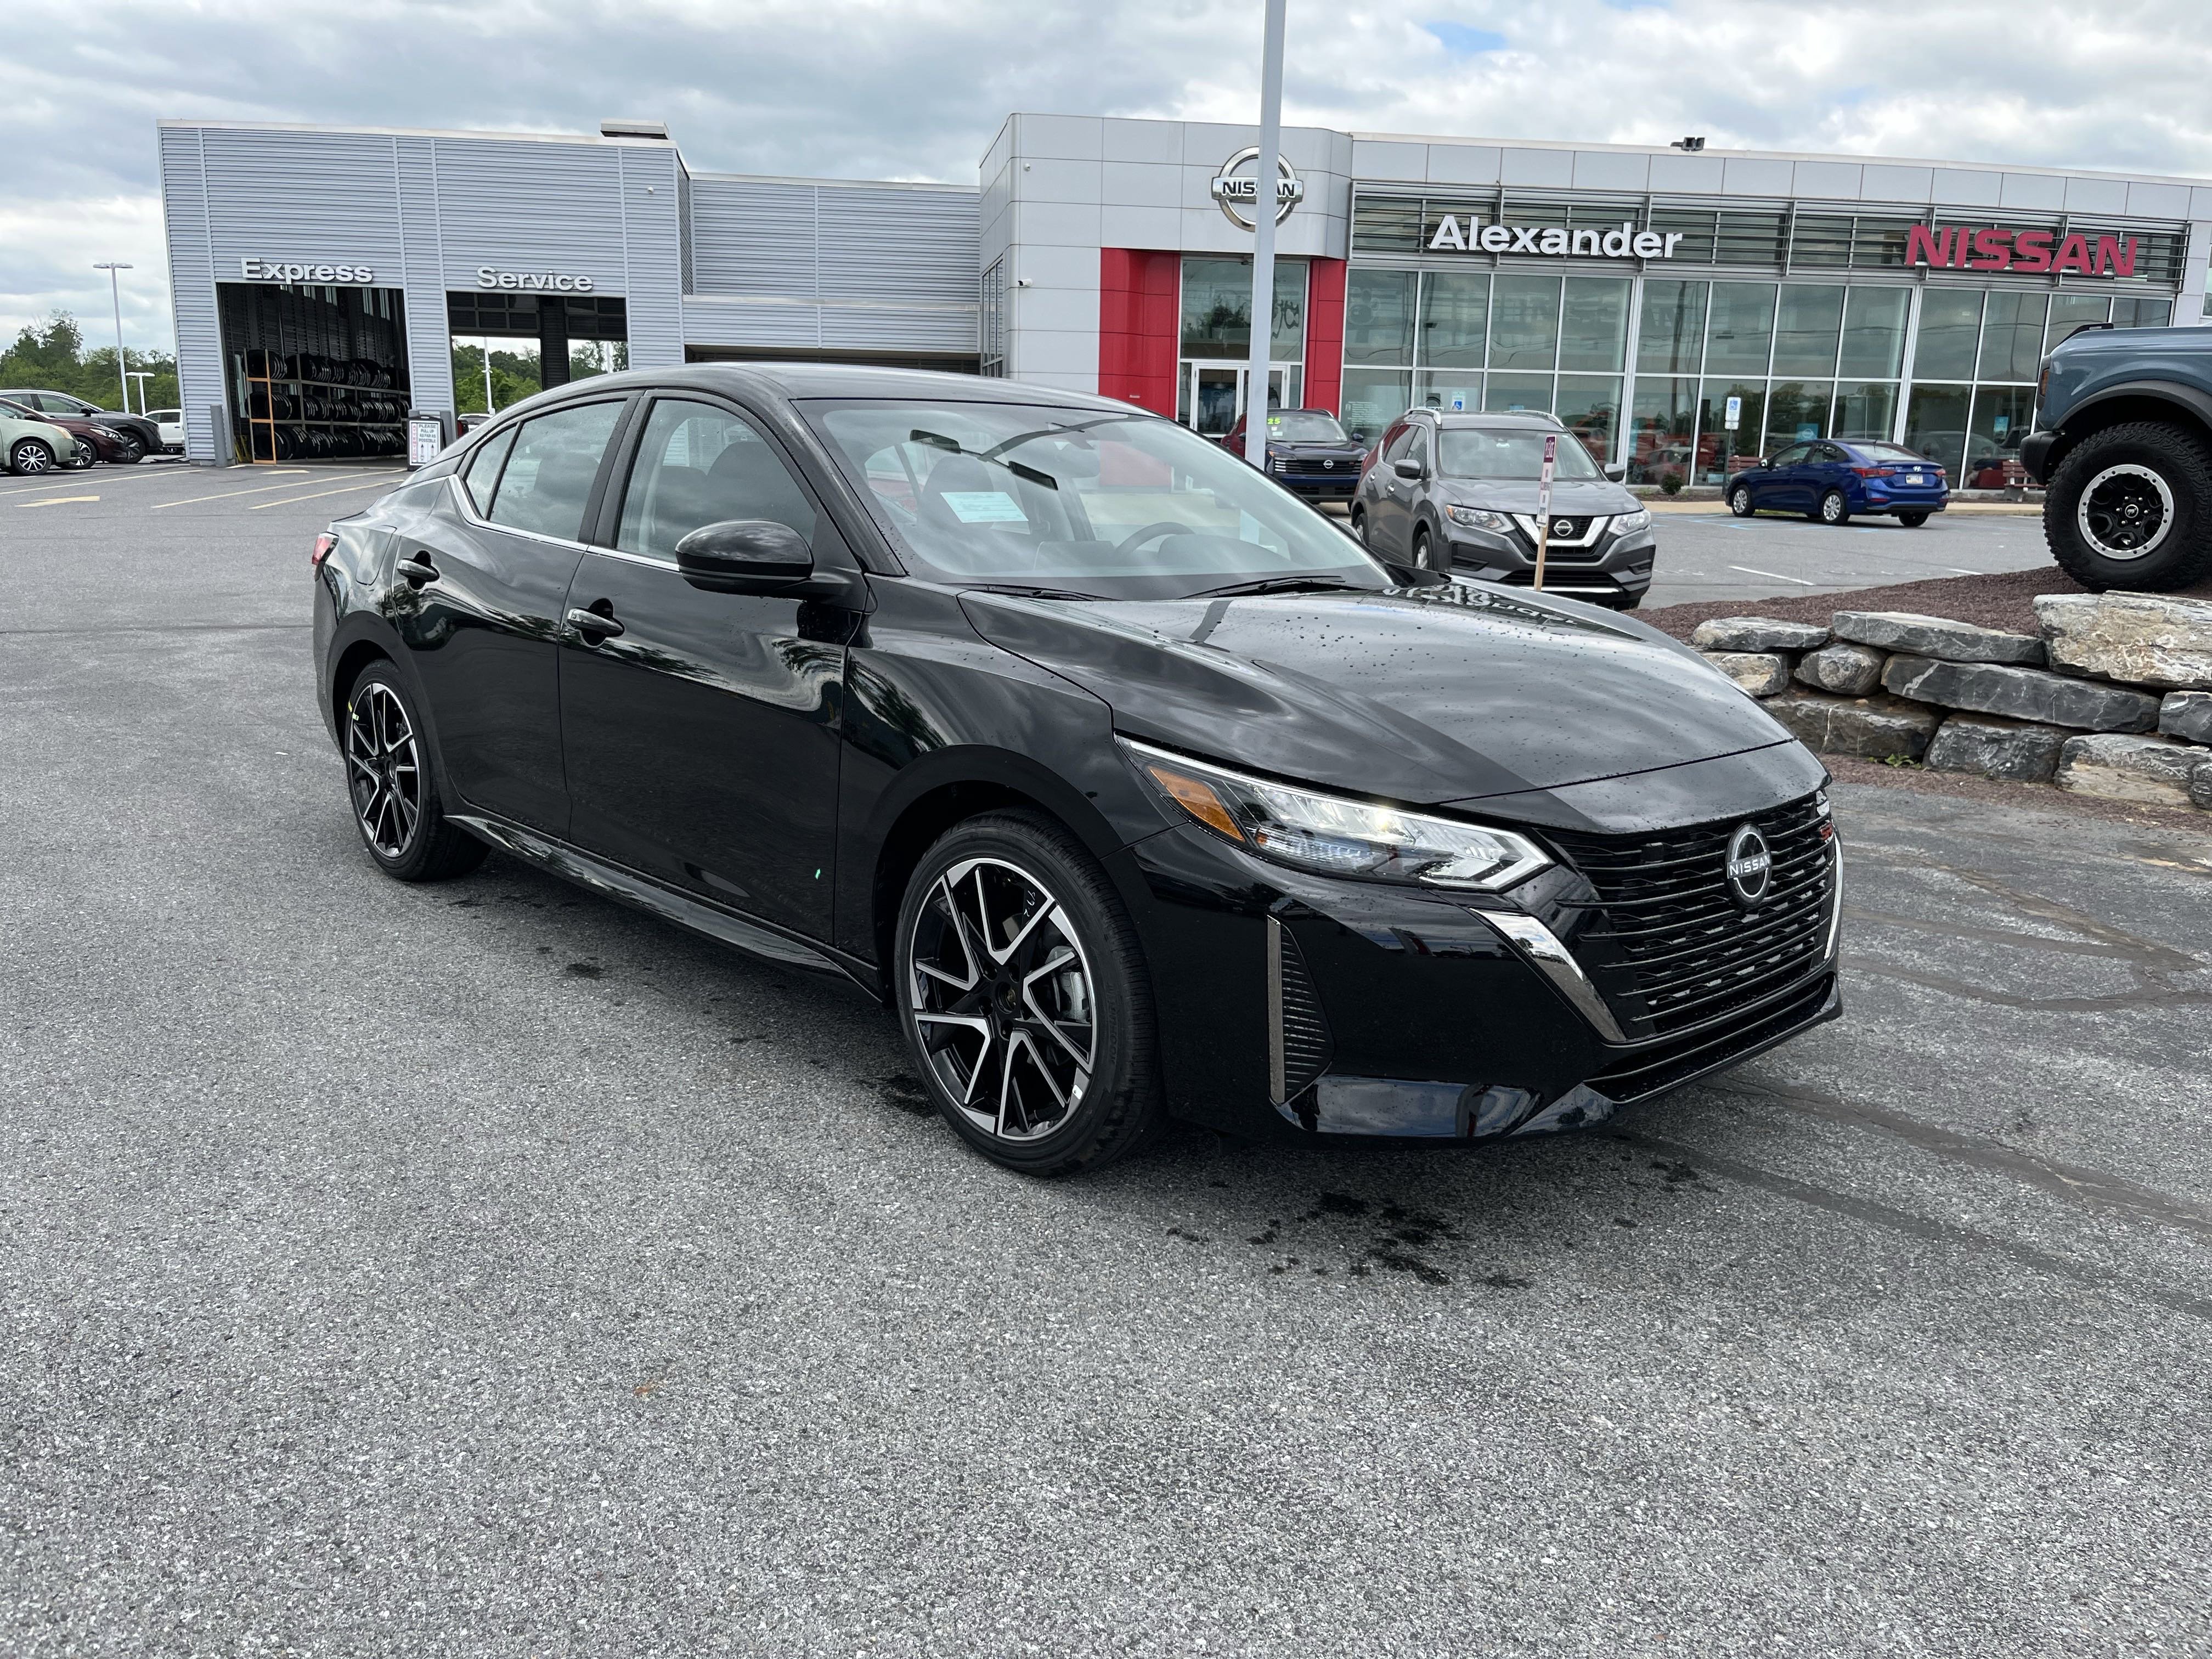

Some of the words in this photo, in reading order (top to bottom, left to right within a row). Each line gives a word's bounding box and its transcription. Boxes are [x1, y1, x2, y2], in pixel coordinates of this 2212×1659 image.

[1222, 181, 1295, 198] NISN
[1429, 215, 1683, 258] Alexander
[1905, 224, 2138, 276] NISSAN
[240, 257, 373, 285] Express
[477, 266, 593, 291] Service
[1729, 855, 1771, 876] NISSAN
